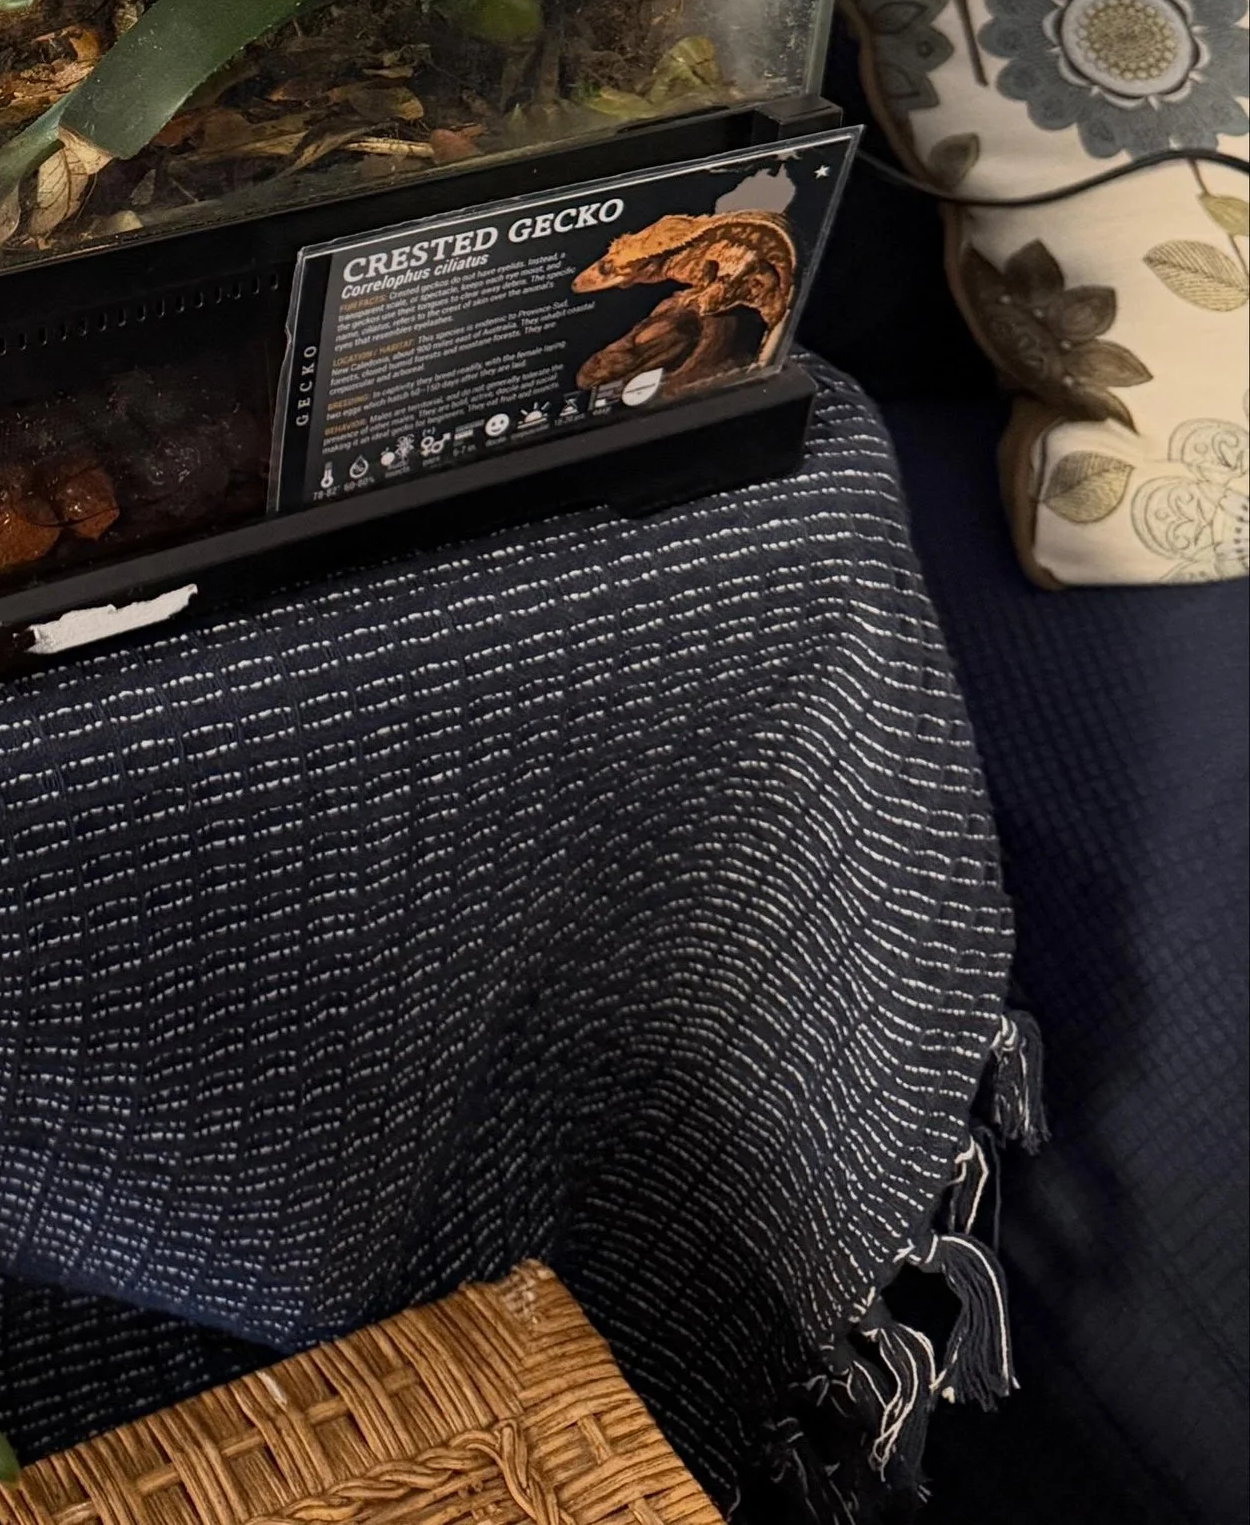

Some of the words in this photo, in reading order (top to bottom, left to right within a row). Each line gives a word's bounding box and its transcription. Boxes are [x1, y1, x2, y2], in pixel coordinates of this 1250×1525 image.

[342, 266, 430, 298] Correlophus
[433, 250, 490, 276] ciliatus
[343, 226, 498, 283] CRESTED
[507, 196, 625, 243] GECKO
[296, 345, 317, 426] GECKO
